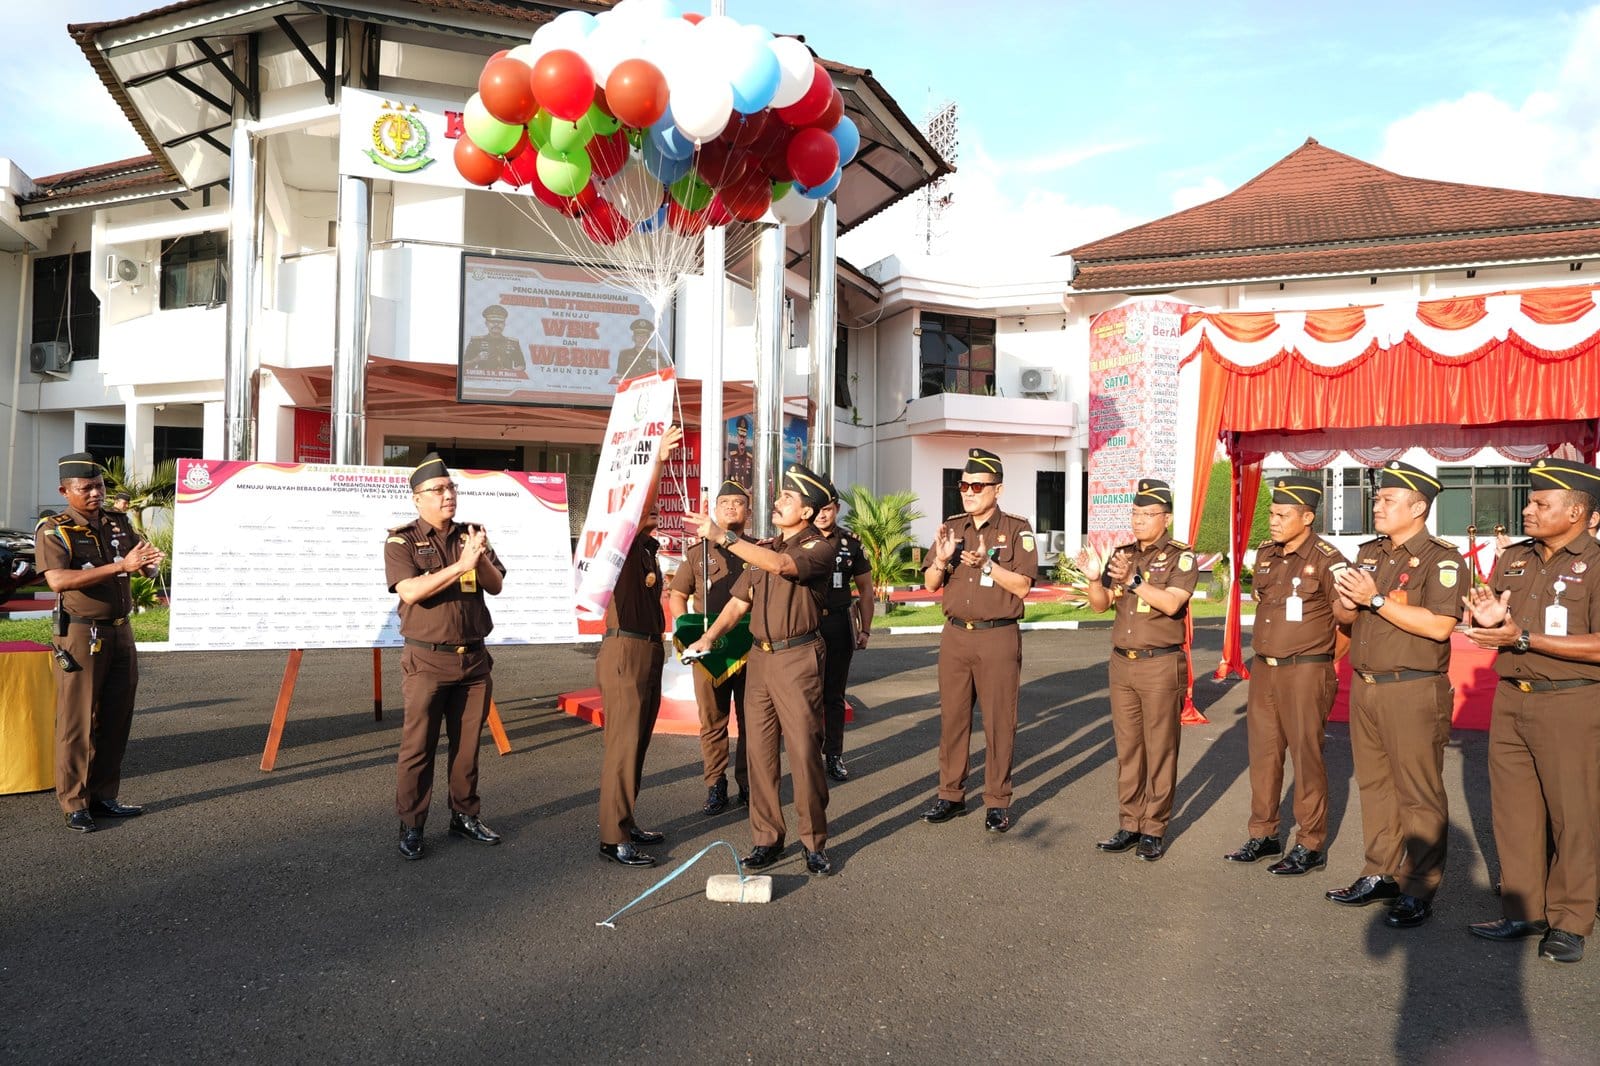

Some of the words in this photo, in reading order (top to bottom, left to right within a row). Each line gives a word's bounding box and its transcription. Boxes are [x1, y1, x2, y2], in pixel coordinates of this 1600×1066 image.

[444, 110, 466, 139] K
[513, 286, 570, 297] PENCANANGAN
[571, 291, 628, 302] PEMBANGUNAN
[552, 311, 590, 319] MENUJU
[541, 318, 600, 340] WBK
[529, 344, 610, 369] WBBM
[540, 366, 572, 374] TAHUN
[1105, 374, 1129, 389] SATYA
[1107, 436, 1126, 447] ADHI
[330, 475, 386, 483] KOMITMEN
[388, 476, 411, 484] BER
[1092, 493, 1136, 505] WICAKSAN
[657, 515, 685, 529] BIAYA
